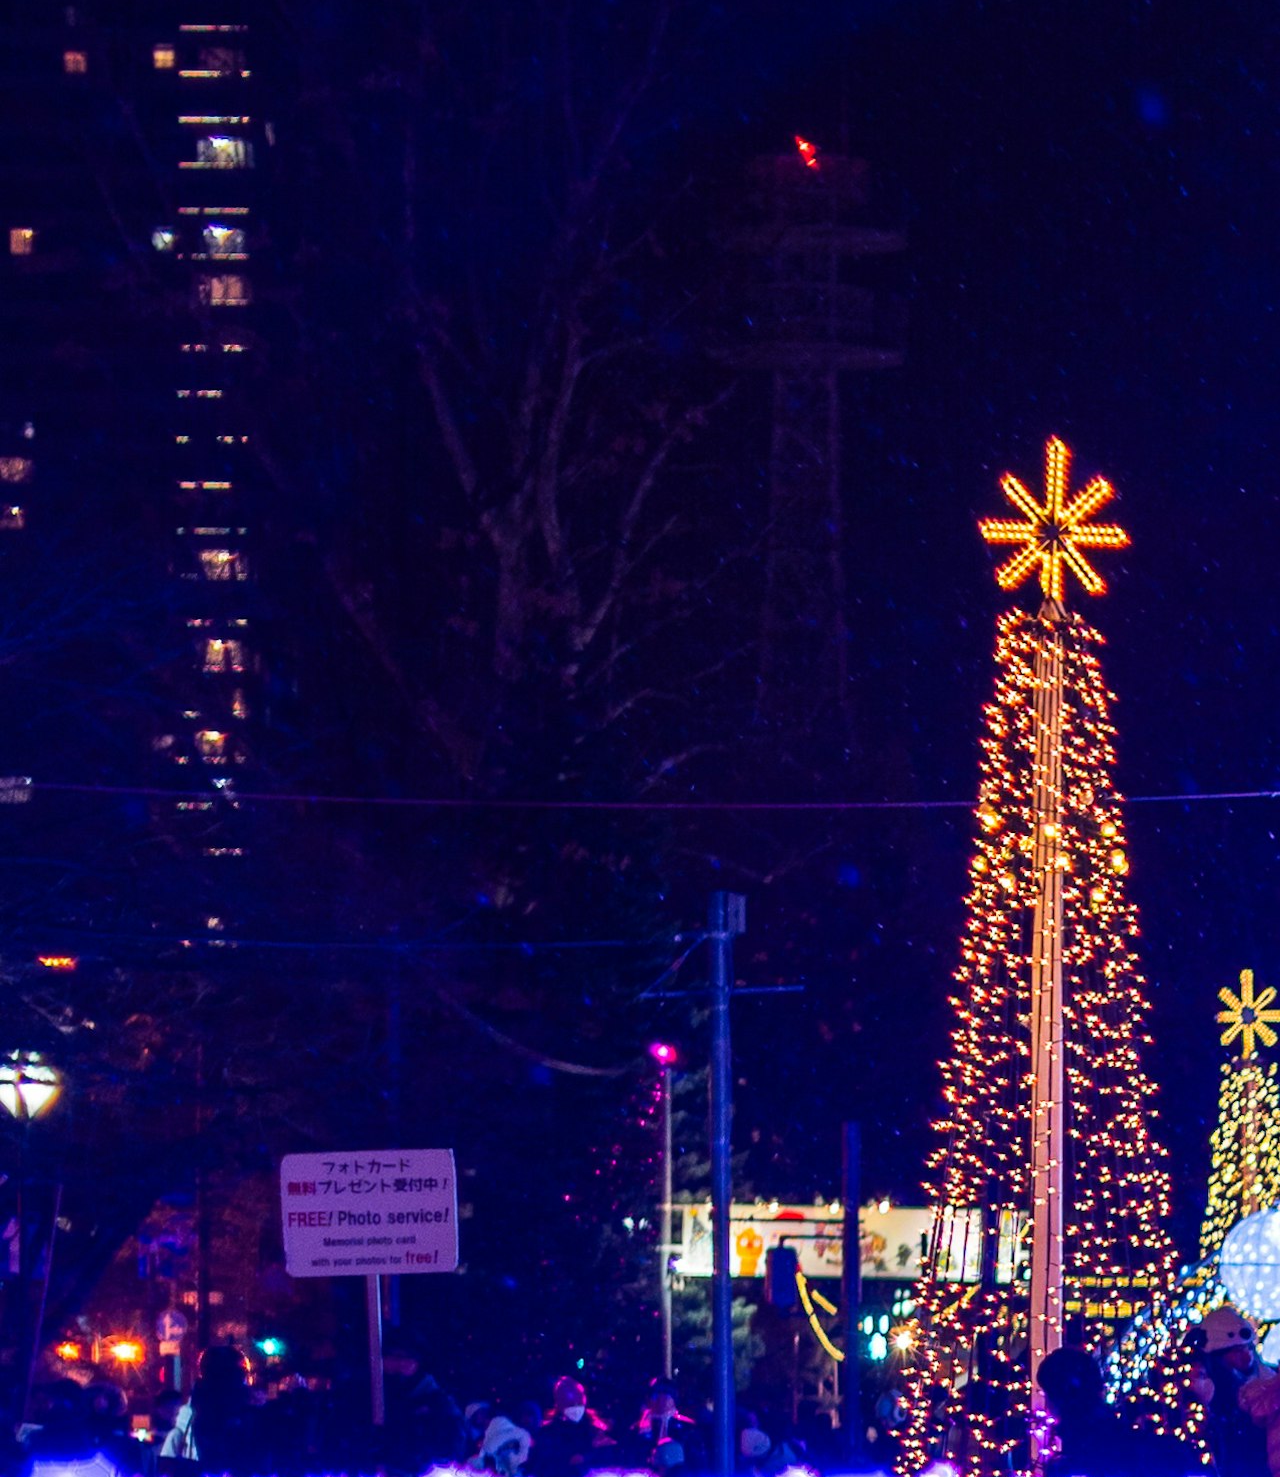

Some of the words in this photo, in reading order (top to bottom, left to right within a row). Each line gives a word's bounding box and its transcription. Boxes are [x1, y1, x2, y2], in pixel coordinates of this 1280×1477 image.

[322, 1158, 410, 1175] フォトカード
[287, 1211, 333, 1228] FREE!
[338, 1210, 381, 1226] Photo
[387, 1207, 449, 1224] service!
[323, 1236, 364, 1247] Memorial
[367, 1235, 393, 1246] photo
[395, 1235, 416, 1245] card
[311, 1257, 330, 1267] with
[334, 1257, 352, 1268] your
[356, 1256, 386, 1267] photos
[390, 1256, 402, 1265] for
[405, 1250, 438, 1265] free!
